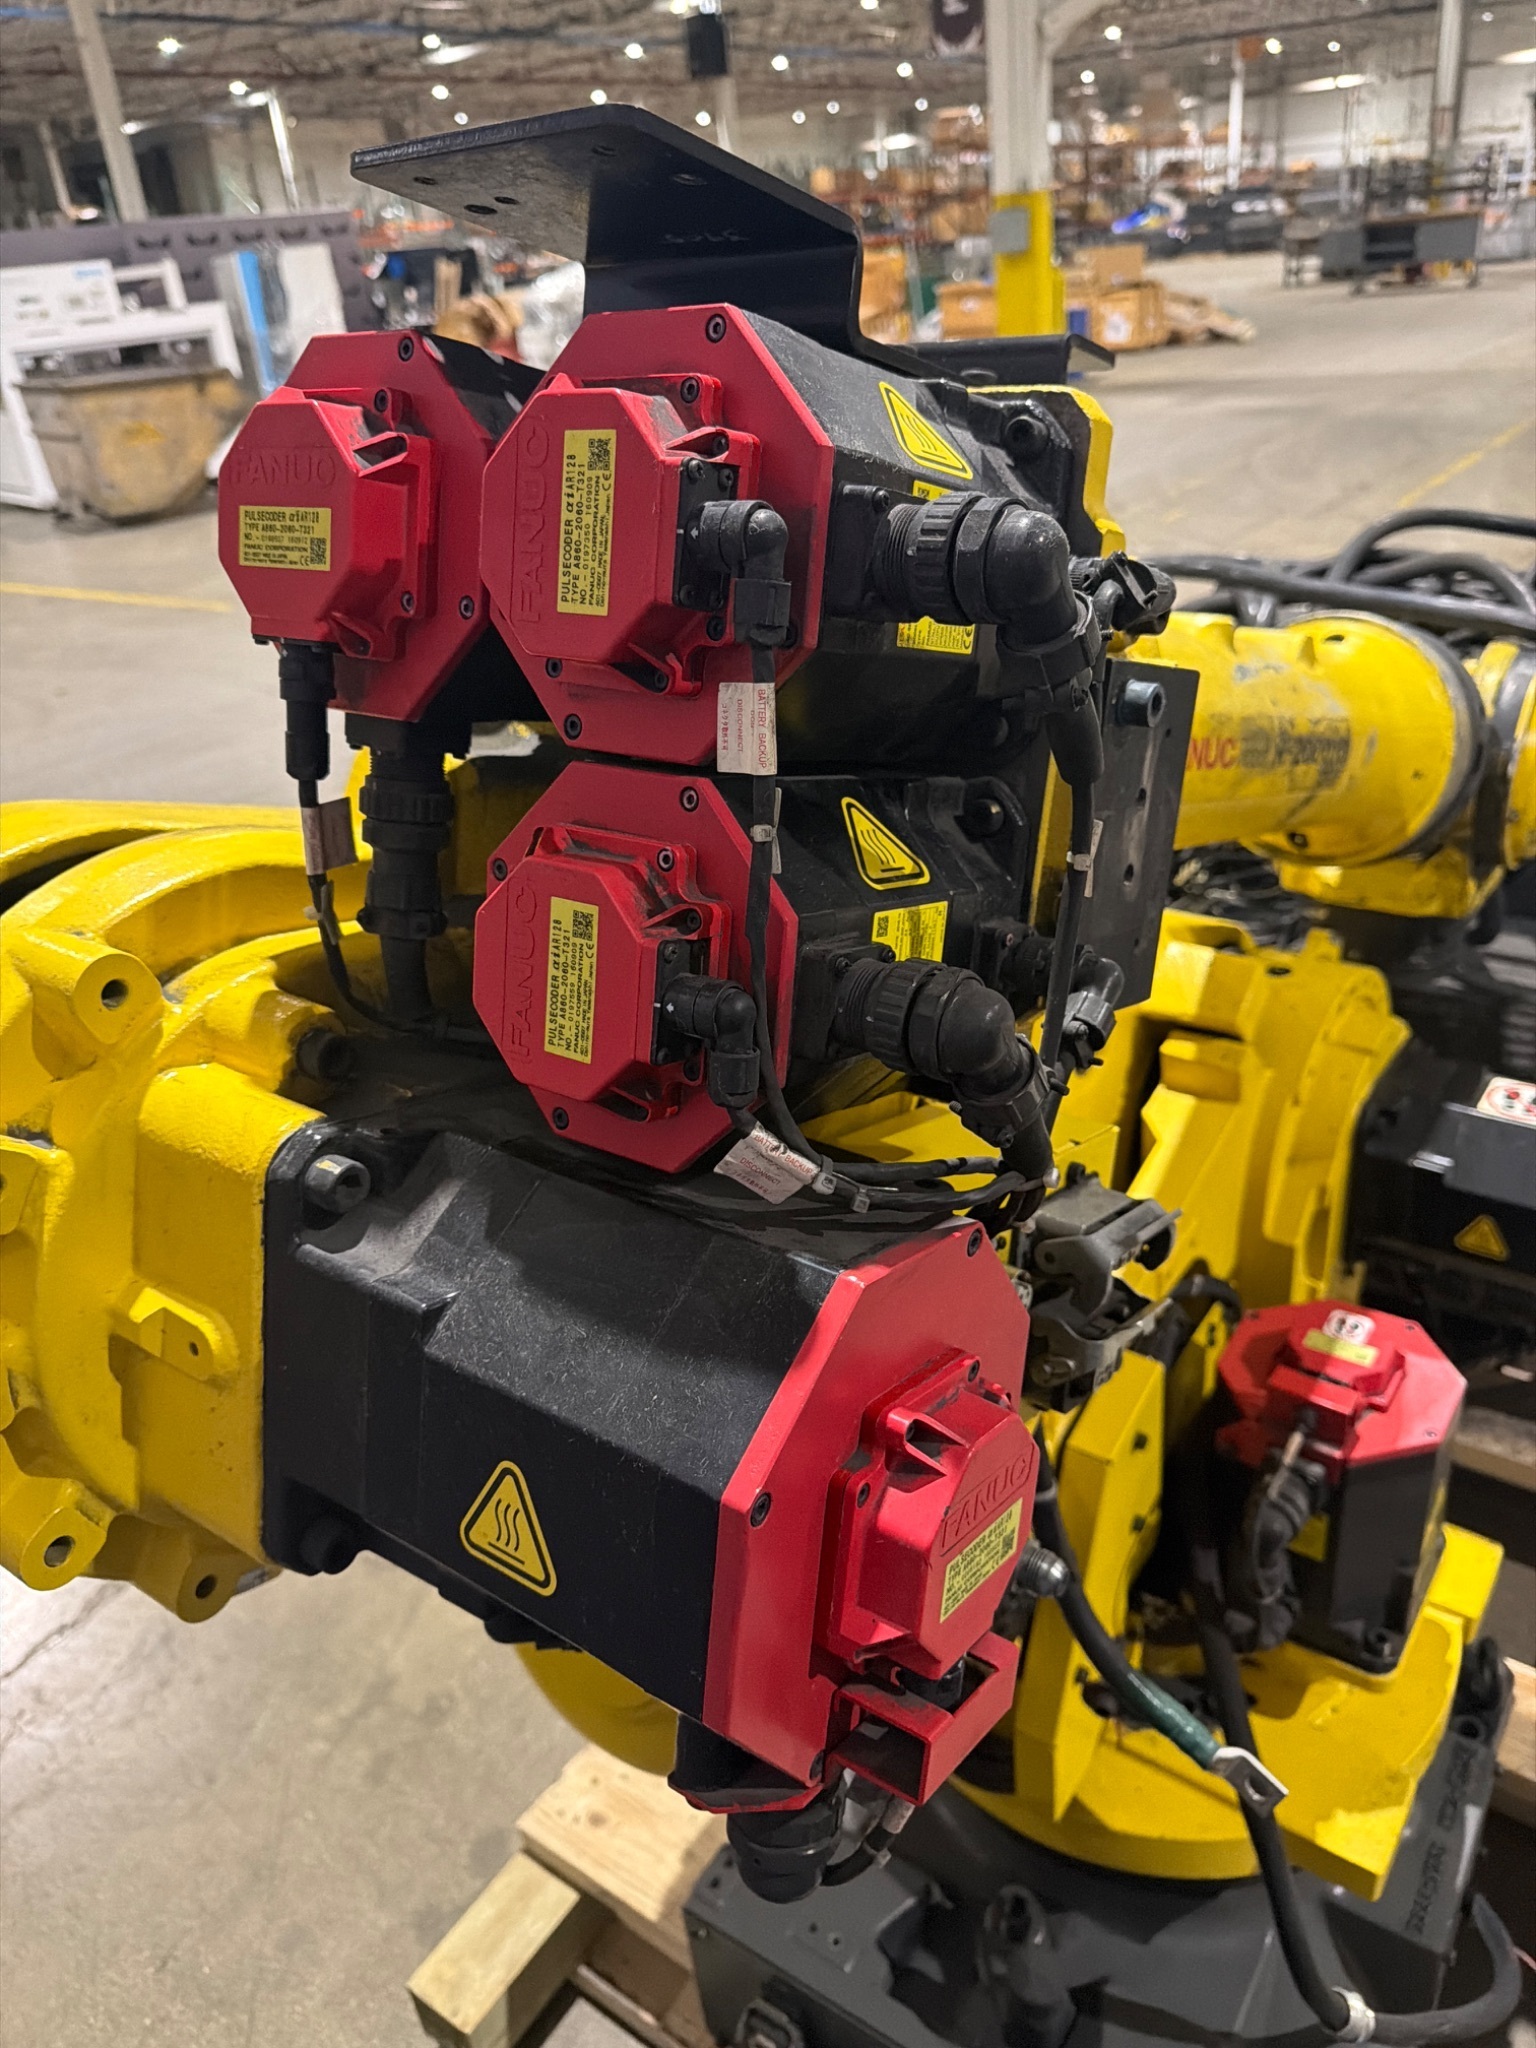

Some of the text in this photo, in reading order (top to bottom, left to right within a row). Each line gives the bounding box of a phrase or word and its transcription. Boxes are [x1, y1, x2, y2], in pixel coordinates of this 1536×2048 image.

[229, 453, 337, 488] FANUC
[584, 476, 593, 515] 160909
[244, 510, 286, 522] PULSECODER
[244, 522, 259, 531] TYPE
[517, 425, 550, 624] FANUC
[570, 463, 585, 603] TYPE A860-2060-T321
[588, 475, 600, 605] FANUC CORPORATION
[560, 518, 573, 603] PULSECODER
[736, 699, 744, 752] DISCONNECT
[757, 689, 768, 768] BATTERY BACKUP
[510, 885, 538, 1061] FANUC
[547, 973, 559, 1047] PULSECODER
[557, 928, 570, 1048] TYPE A860-2060-T321
[575, 942, 584, 1017] CORPORATION
[740, 1157, 781, 1185] DISCONNECT
[784, 1154, 814, 1175] BACKUP
[941, 1454, 1027, 1549] FANUC
